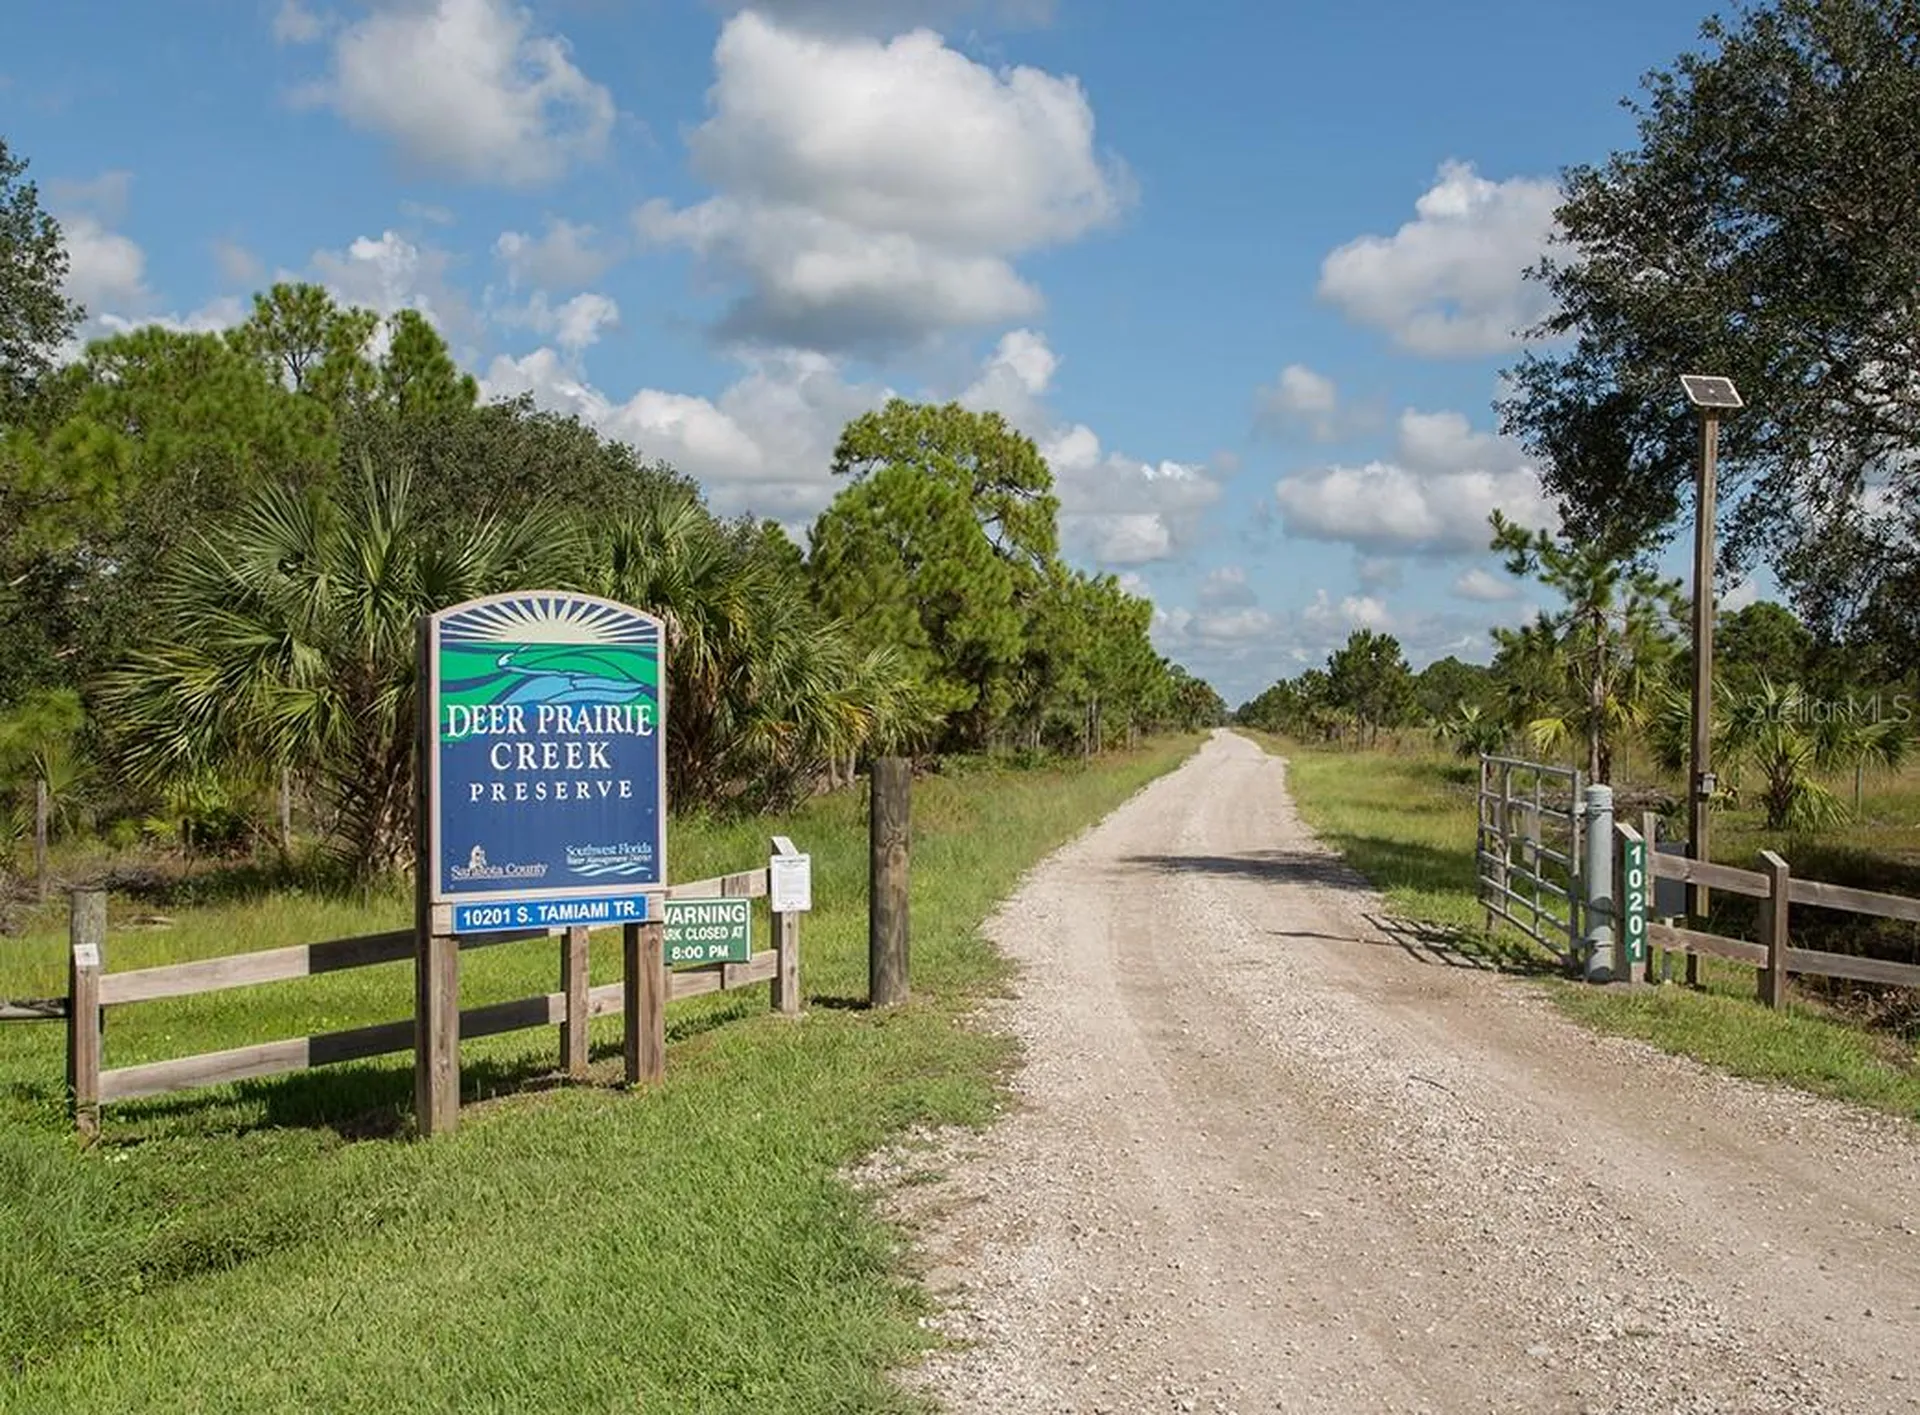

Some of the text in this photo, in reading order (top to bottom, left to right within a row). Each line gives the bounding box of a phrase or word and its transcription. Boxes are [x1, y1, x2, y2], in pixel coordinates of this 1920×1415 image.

[447, 704, 653, 737] DEER PRAIRIE
[490, 741, 611, 771] CREEK
[469, 780, 632, 802] PRESERVE
[505, 862, 548, 877] County
[1629, 846, 1643, 958] 10201
[463, 902, 640, 926] 10201 S. TAMIAMI TR.
[663, 926, 745, 940] ARK CLOSED AT
[672, 944, 729, 959] 8:00 PM
